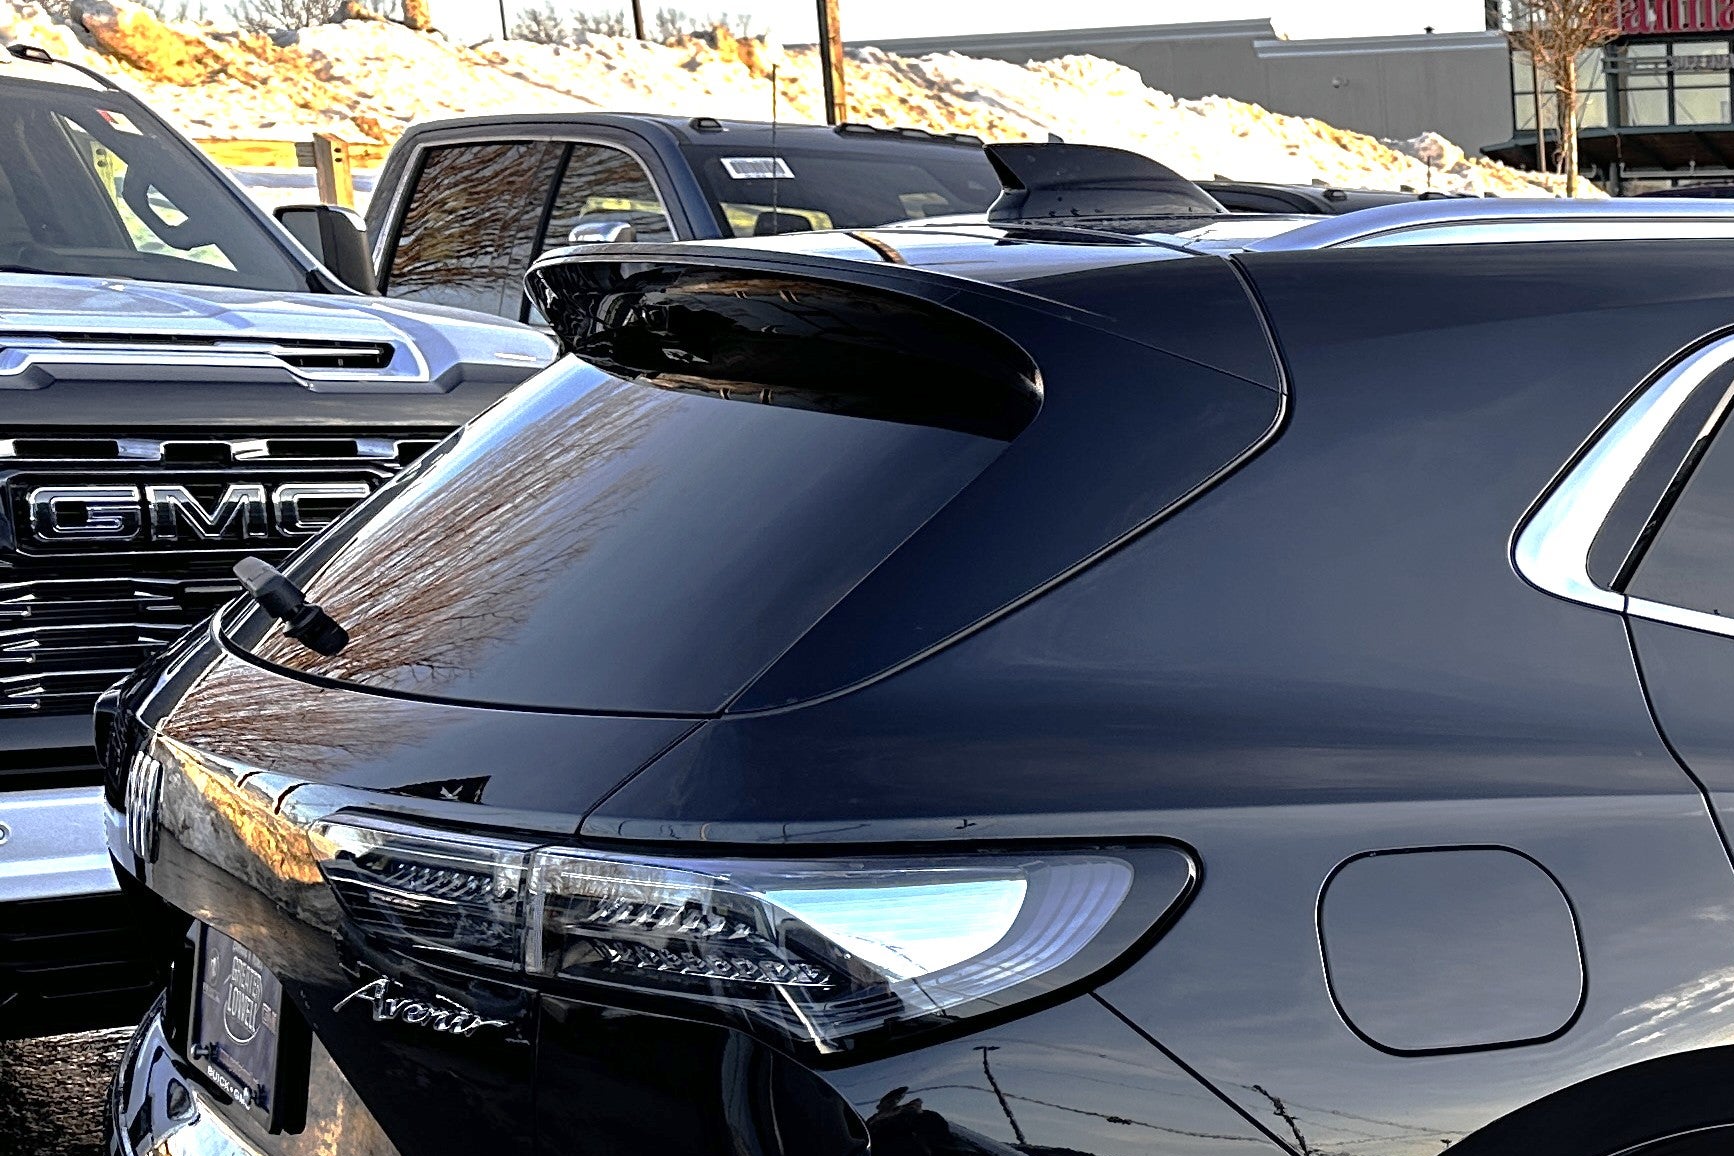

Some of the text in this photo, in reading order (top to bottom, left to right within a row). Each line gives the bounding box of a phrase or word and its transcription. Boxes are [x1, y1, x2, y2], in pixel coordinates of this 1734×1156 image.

[29, 483, 372, 541] GMC
[333, 975, 509, 1038] Avenir
[207, 1065, 230, 1092] BUICK
